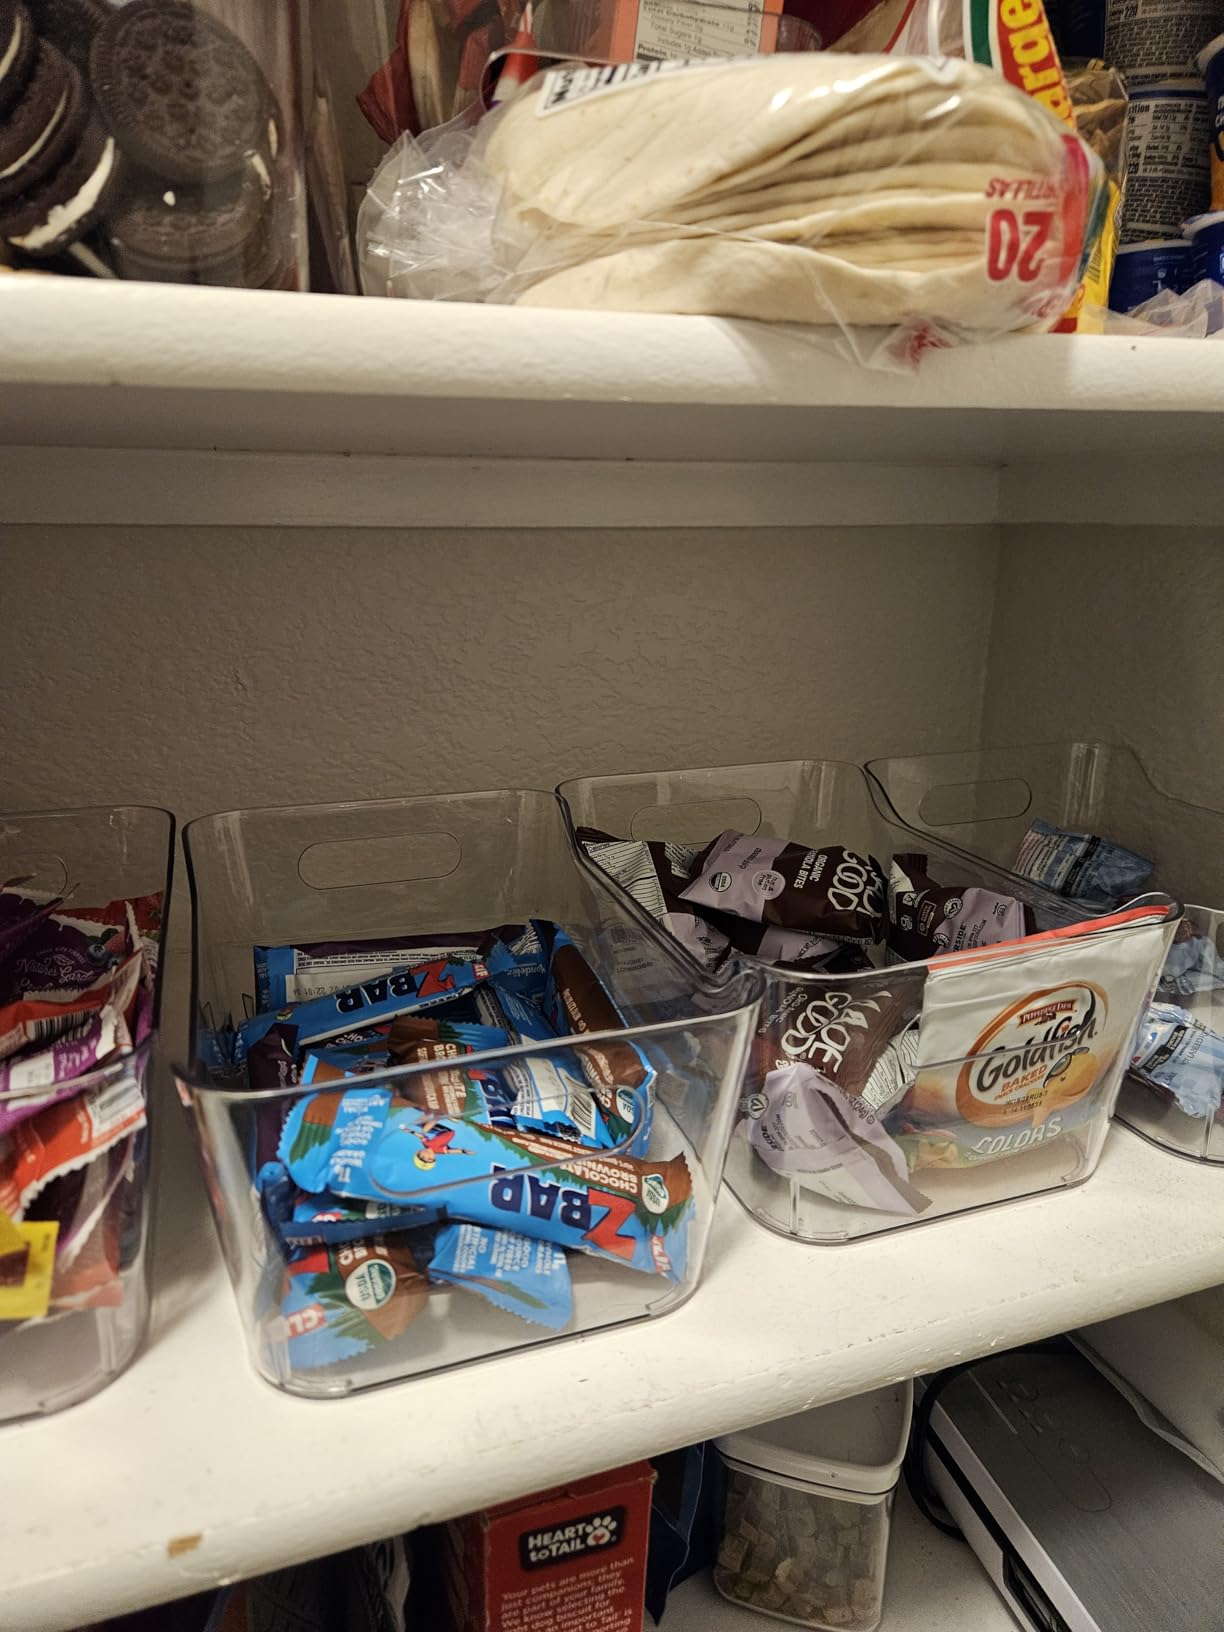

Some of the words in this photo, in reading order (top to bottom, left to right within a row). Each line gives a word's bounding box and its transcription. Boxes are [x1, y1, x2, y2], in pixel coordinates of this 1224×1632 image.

[987, 209, 1055, 282] 20
[336, 959, 455, 1014] ZBAR
[976, 1014, 1098, 1092] Goldfish
[1001, 1064, 1048, 1093] BAKED
[489, 1161, 637, 1262] ZBAR
[527, 1522, 587, 1550] HEART
[500, 1599, 522, 1611] just
[598, 1571, 621, 1584] they
[501, 1589, 528, 1601] Your
[531, 1582, 556, 1595] pets
[558, 1576, 577, 1586] are
[579, 1567, 607, 1579] more
[610, 1557, 635, 1571] than
[501, 1609, 520, 1620] are
[523, 1601, 546, 1616] part
[549, 1597, 561, 1607] of
[564, 1590, 587, 1604] your
[501, 1618, 521, 1629] We
[524, 1609, 553, 1623] know
[556, 1592, 605, 1613] selecting
[607, 1585, 625, 1597] the
[531, 1618, 553, 1631] dog
[556, 1605, 592, 1623] biscuit
[595, 1599, 610, 1611] for
[561, 1605, 615, 1630] important
[585, 1620, 598, 1630] to
[624, 1608, 633, 1617] is
